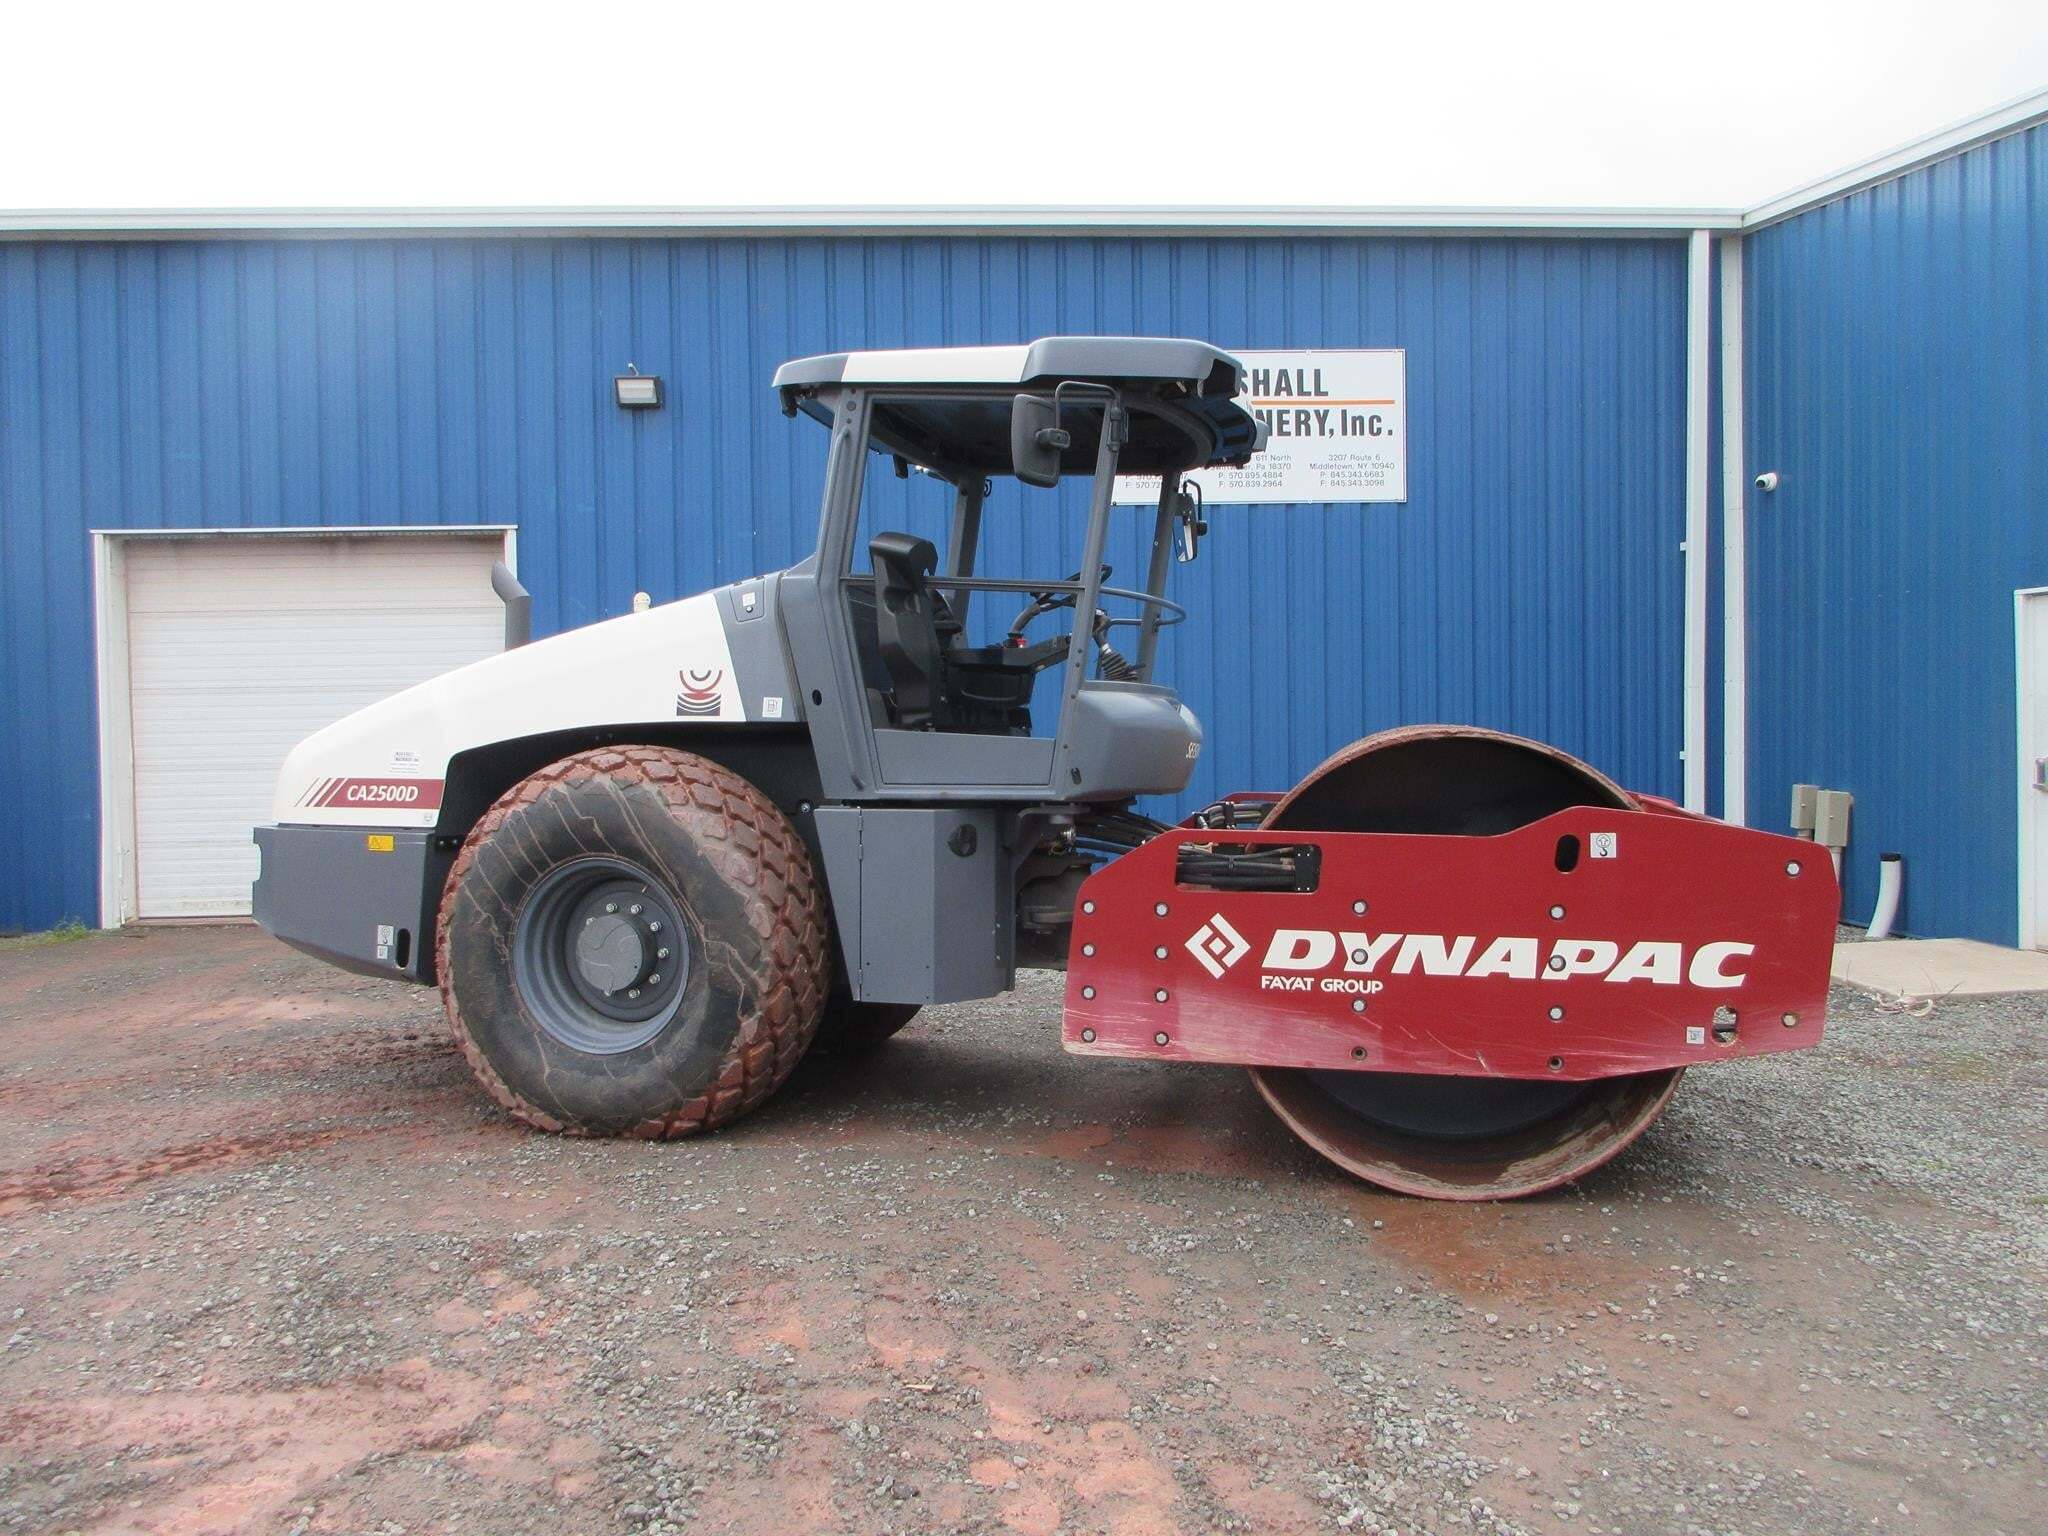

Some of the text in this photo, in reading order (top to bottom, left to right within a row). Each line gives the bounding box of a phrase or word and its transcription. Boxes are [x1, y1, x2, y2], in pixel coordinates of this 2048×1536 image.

[1270, 454, 1292, 462] North
[346, 785, 419, 802] CA2500D
[1261, 929, 1755, 987] DYNAPAC
[1261, 975, 1384, 994] FAYAT GROUP
